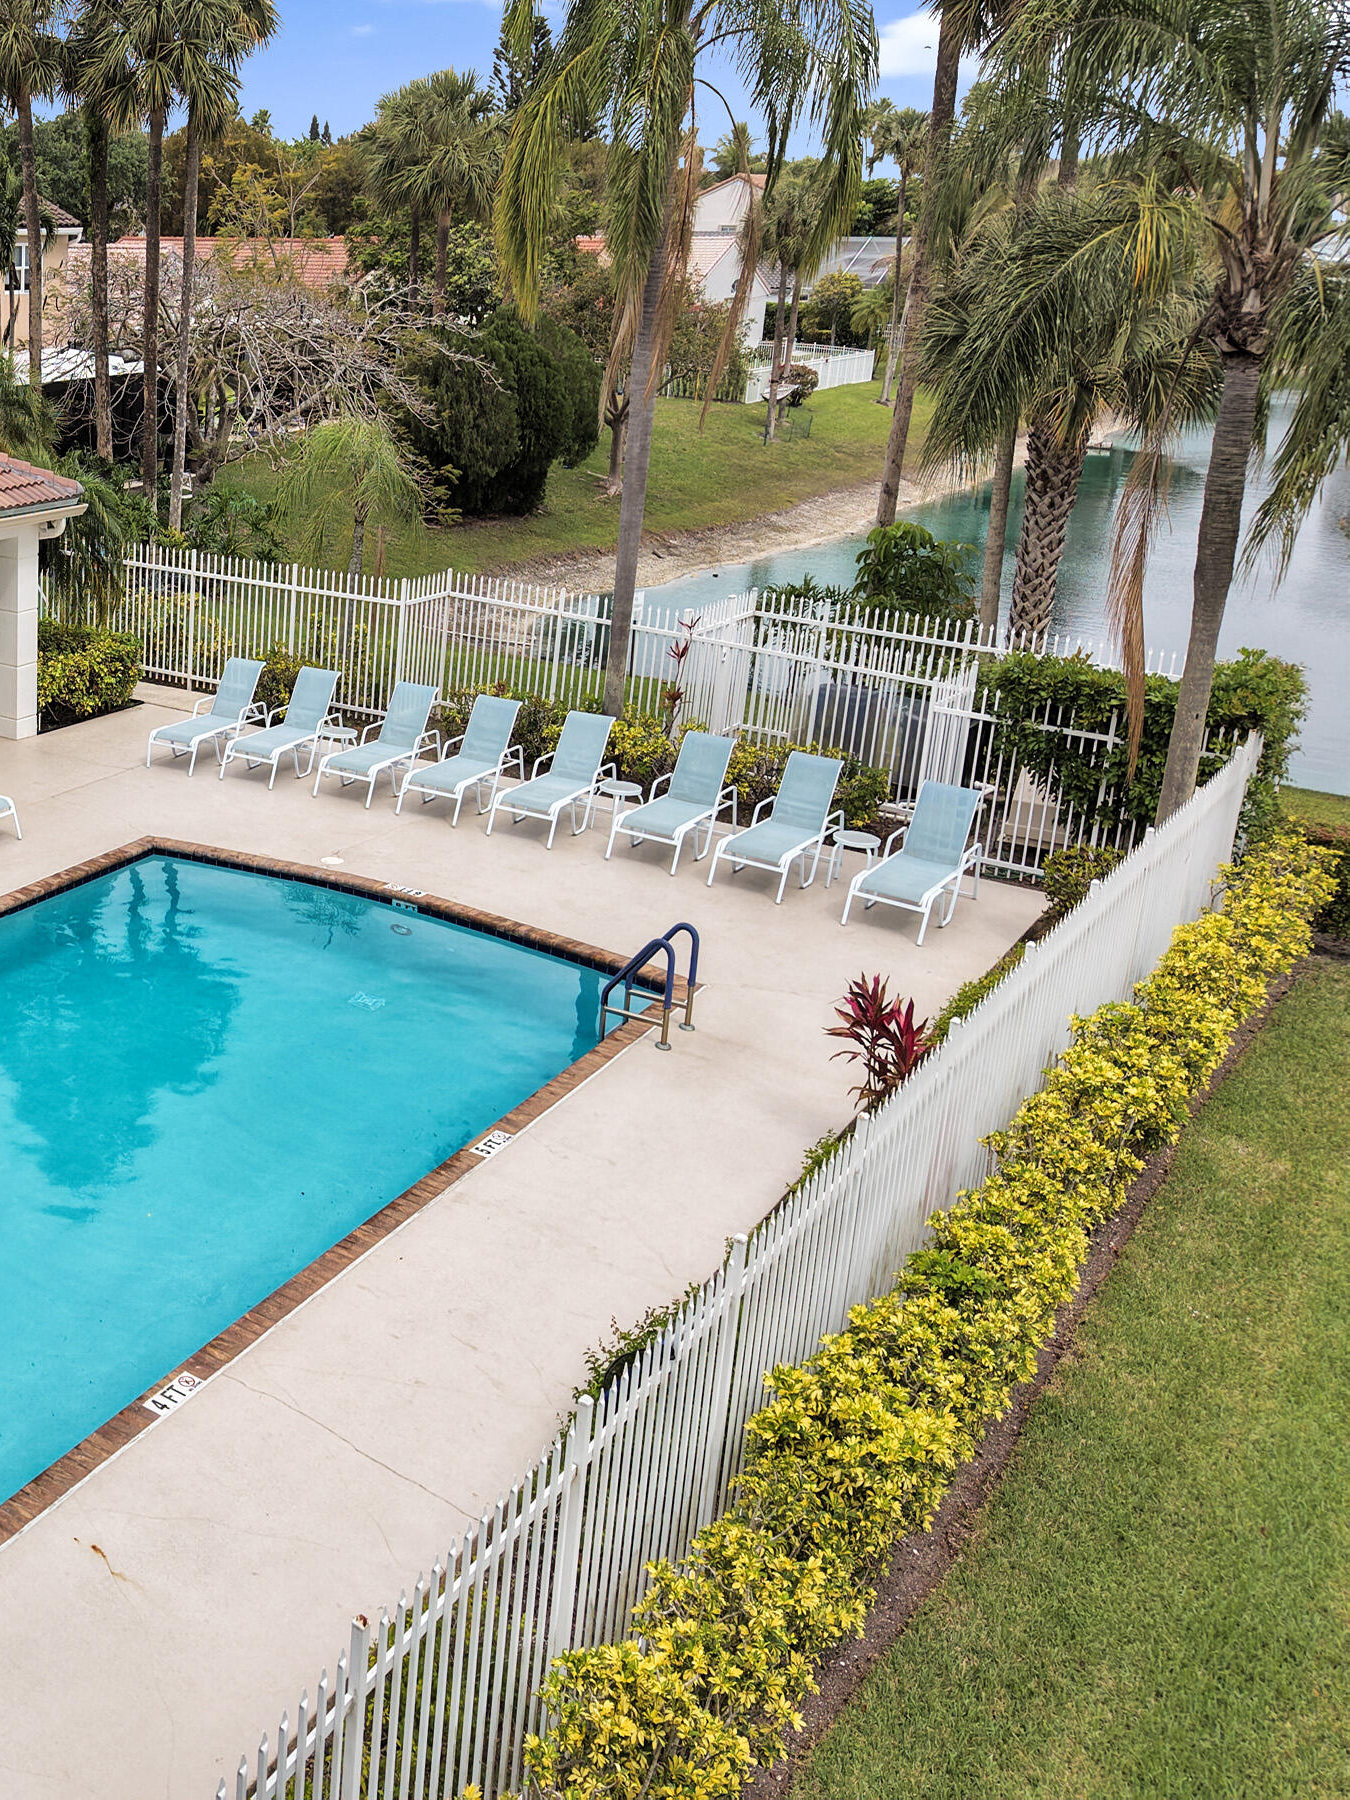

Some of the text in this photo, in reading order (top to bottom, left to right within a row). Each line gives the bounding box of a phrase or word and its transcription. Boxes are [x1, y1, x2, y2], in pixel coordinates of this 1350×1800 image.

[483, 1139, 502, 1150] FT
[160, 1384, 187, 1404] FT
[151, 1399, 170, 1410] 4
